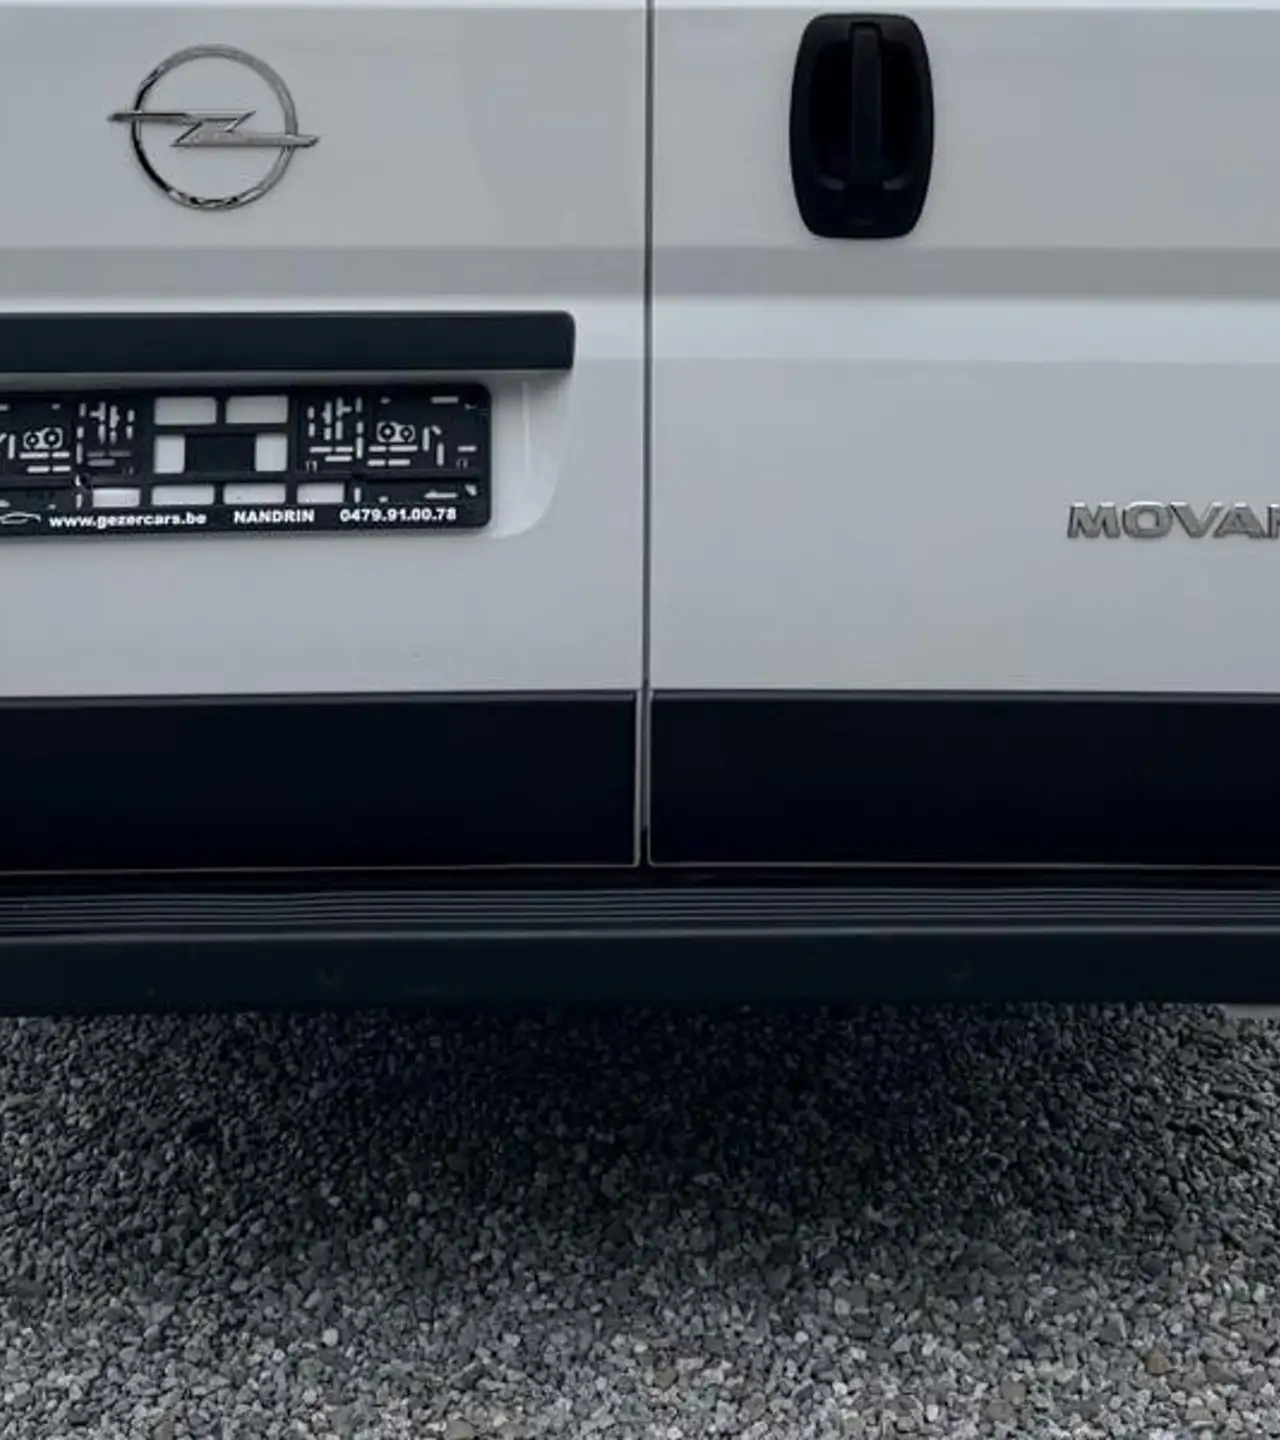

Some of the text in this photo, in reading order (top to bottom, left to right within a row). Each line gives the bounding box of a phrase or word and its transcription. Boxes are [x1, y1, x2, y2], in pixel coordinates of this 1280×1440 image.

[48, 507, 458, 529] www.gezercars.be NANDRIN 0479.91.00.78
